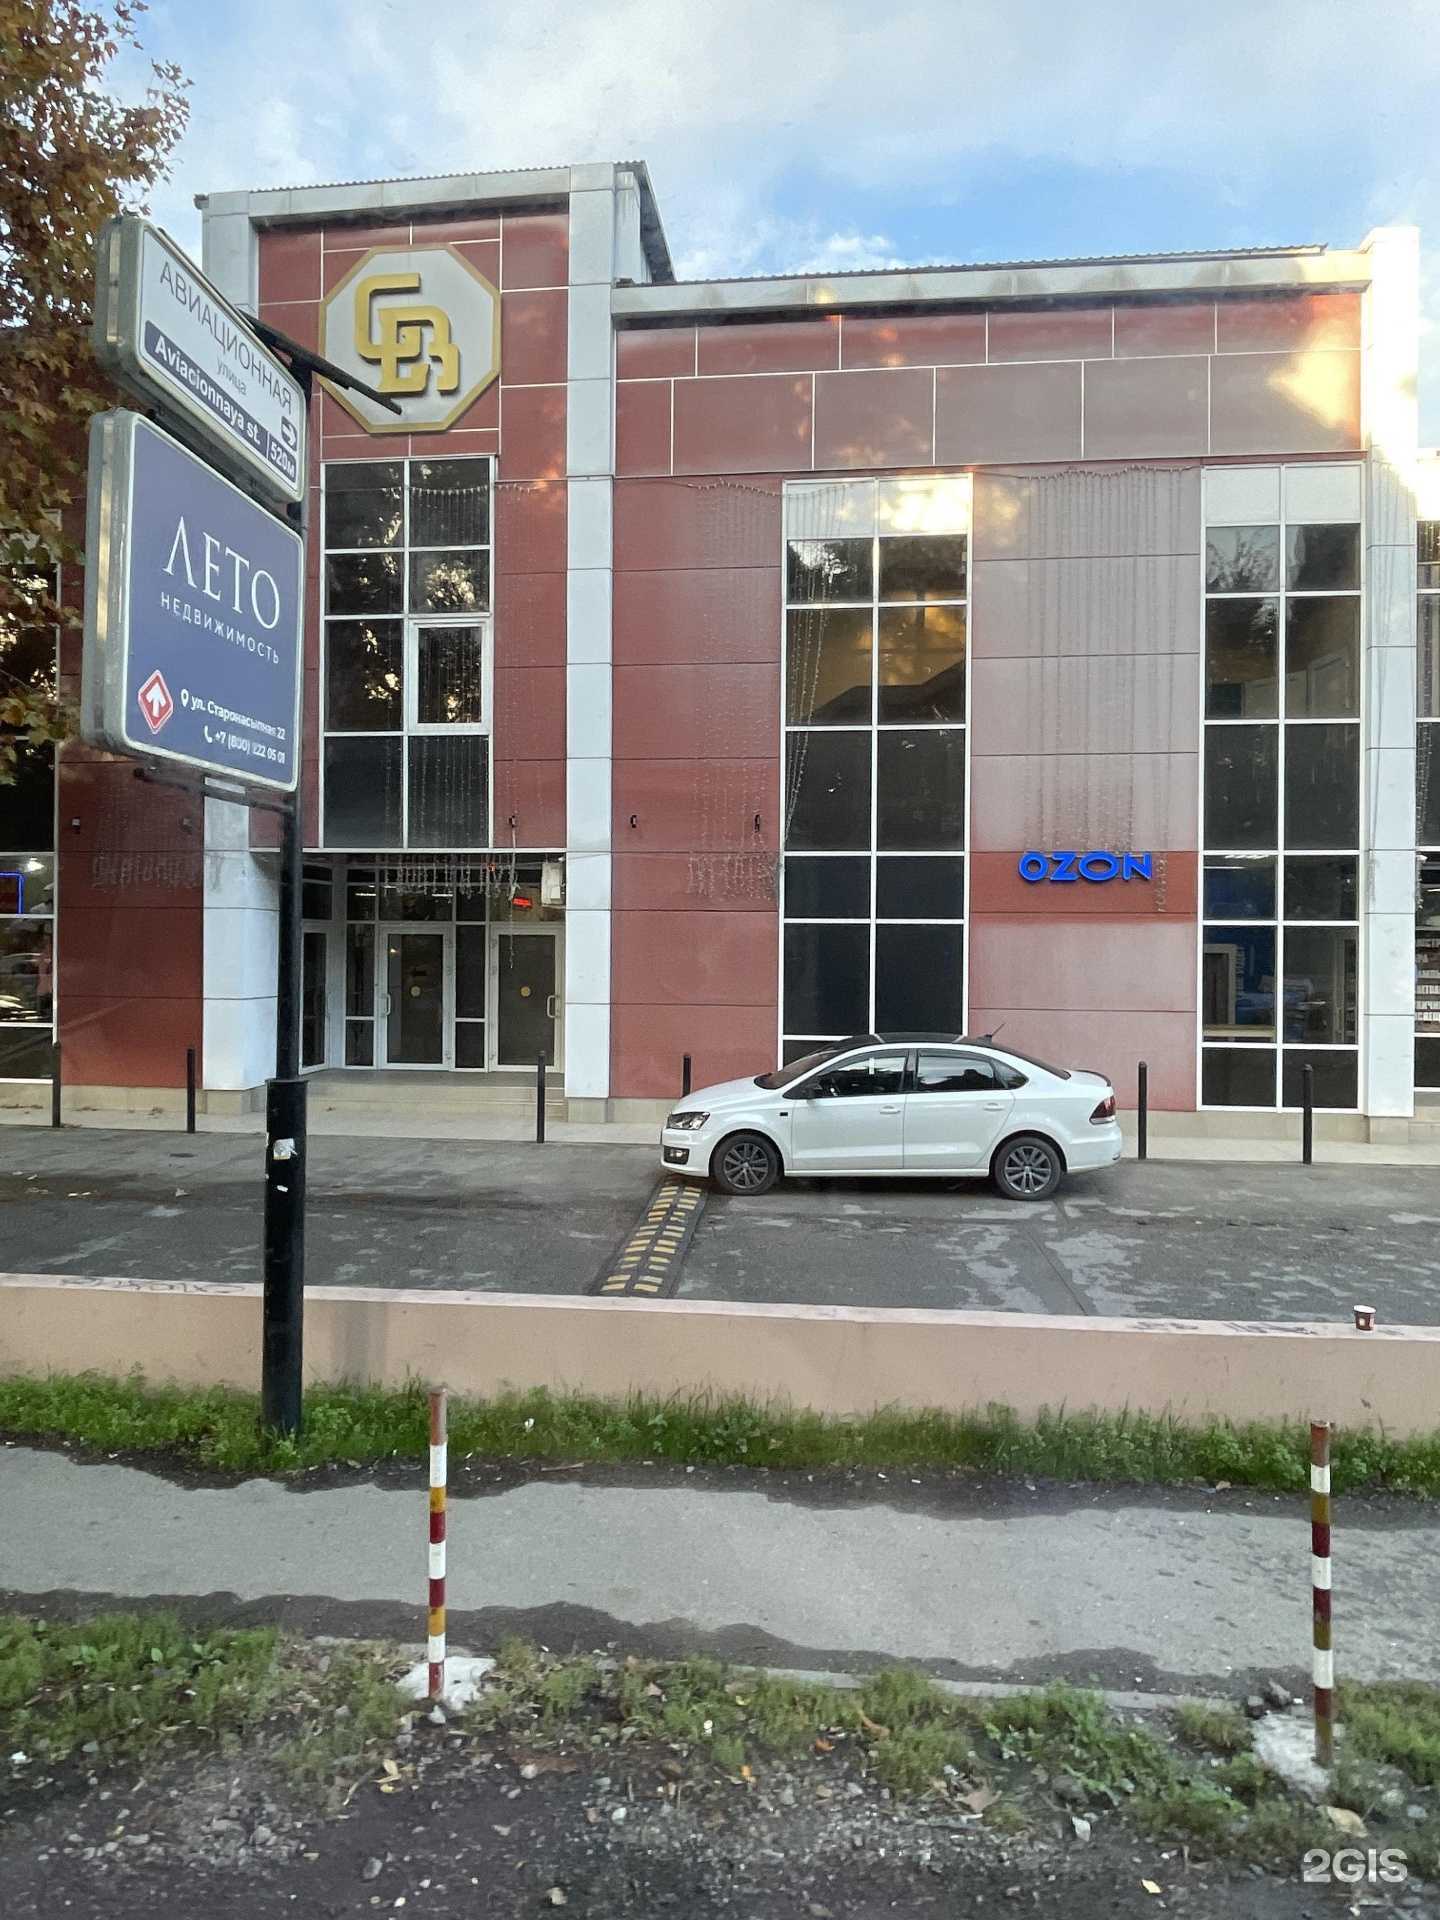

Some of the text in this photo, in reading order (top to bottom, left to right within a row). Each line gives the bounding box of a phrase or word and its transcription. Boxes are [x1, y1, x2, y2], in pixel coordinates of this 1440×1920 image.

[160, 261, 292, 415] АВИАЦИОННАЯ
[216, 355, 247, 396] улица
[154, 334, 261, 446] Aviacionnaya st.
[162, 516, 281, 629] ЛЕТО
[161, 591, 280, 664] НЕДВИЖИМОСТЬ
[1018, 850, 1153, 882] OZON
